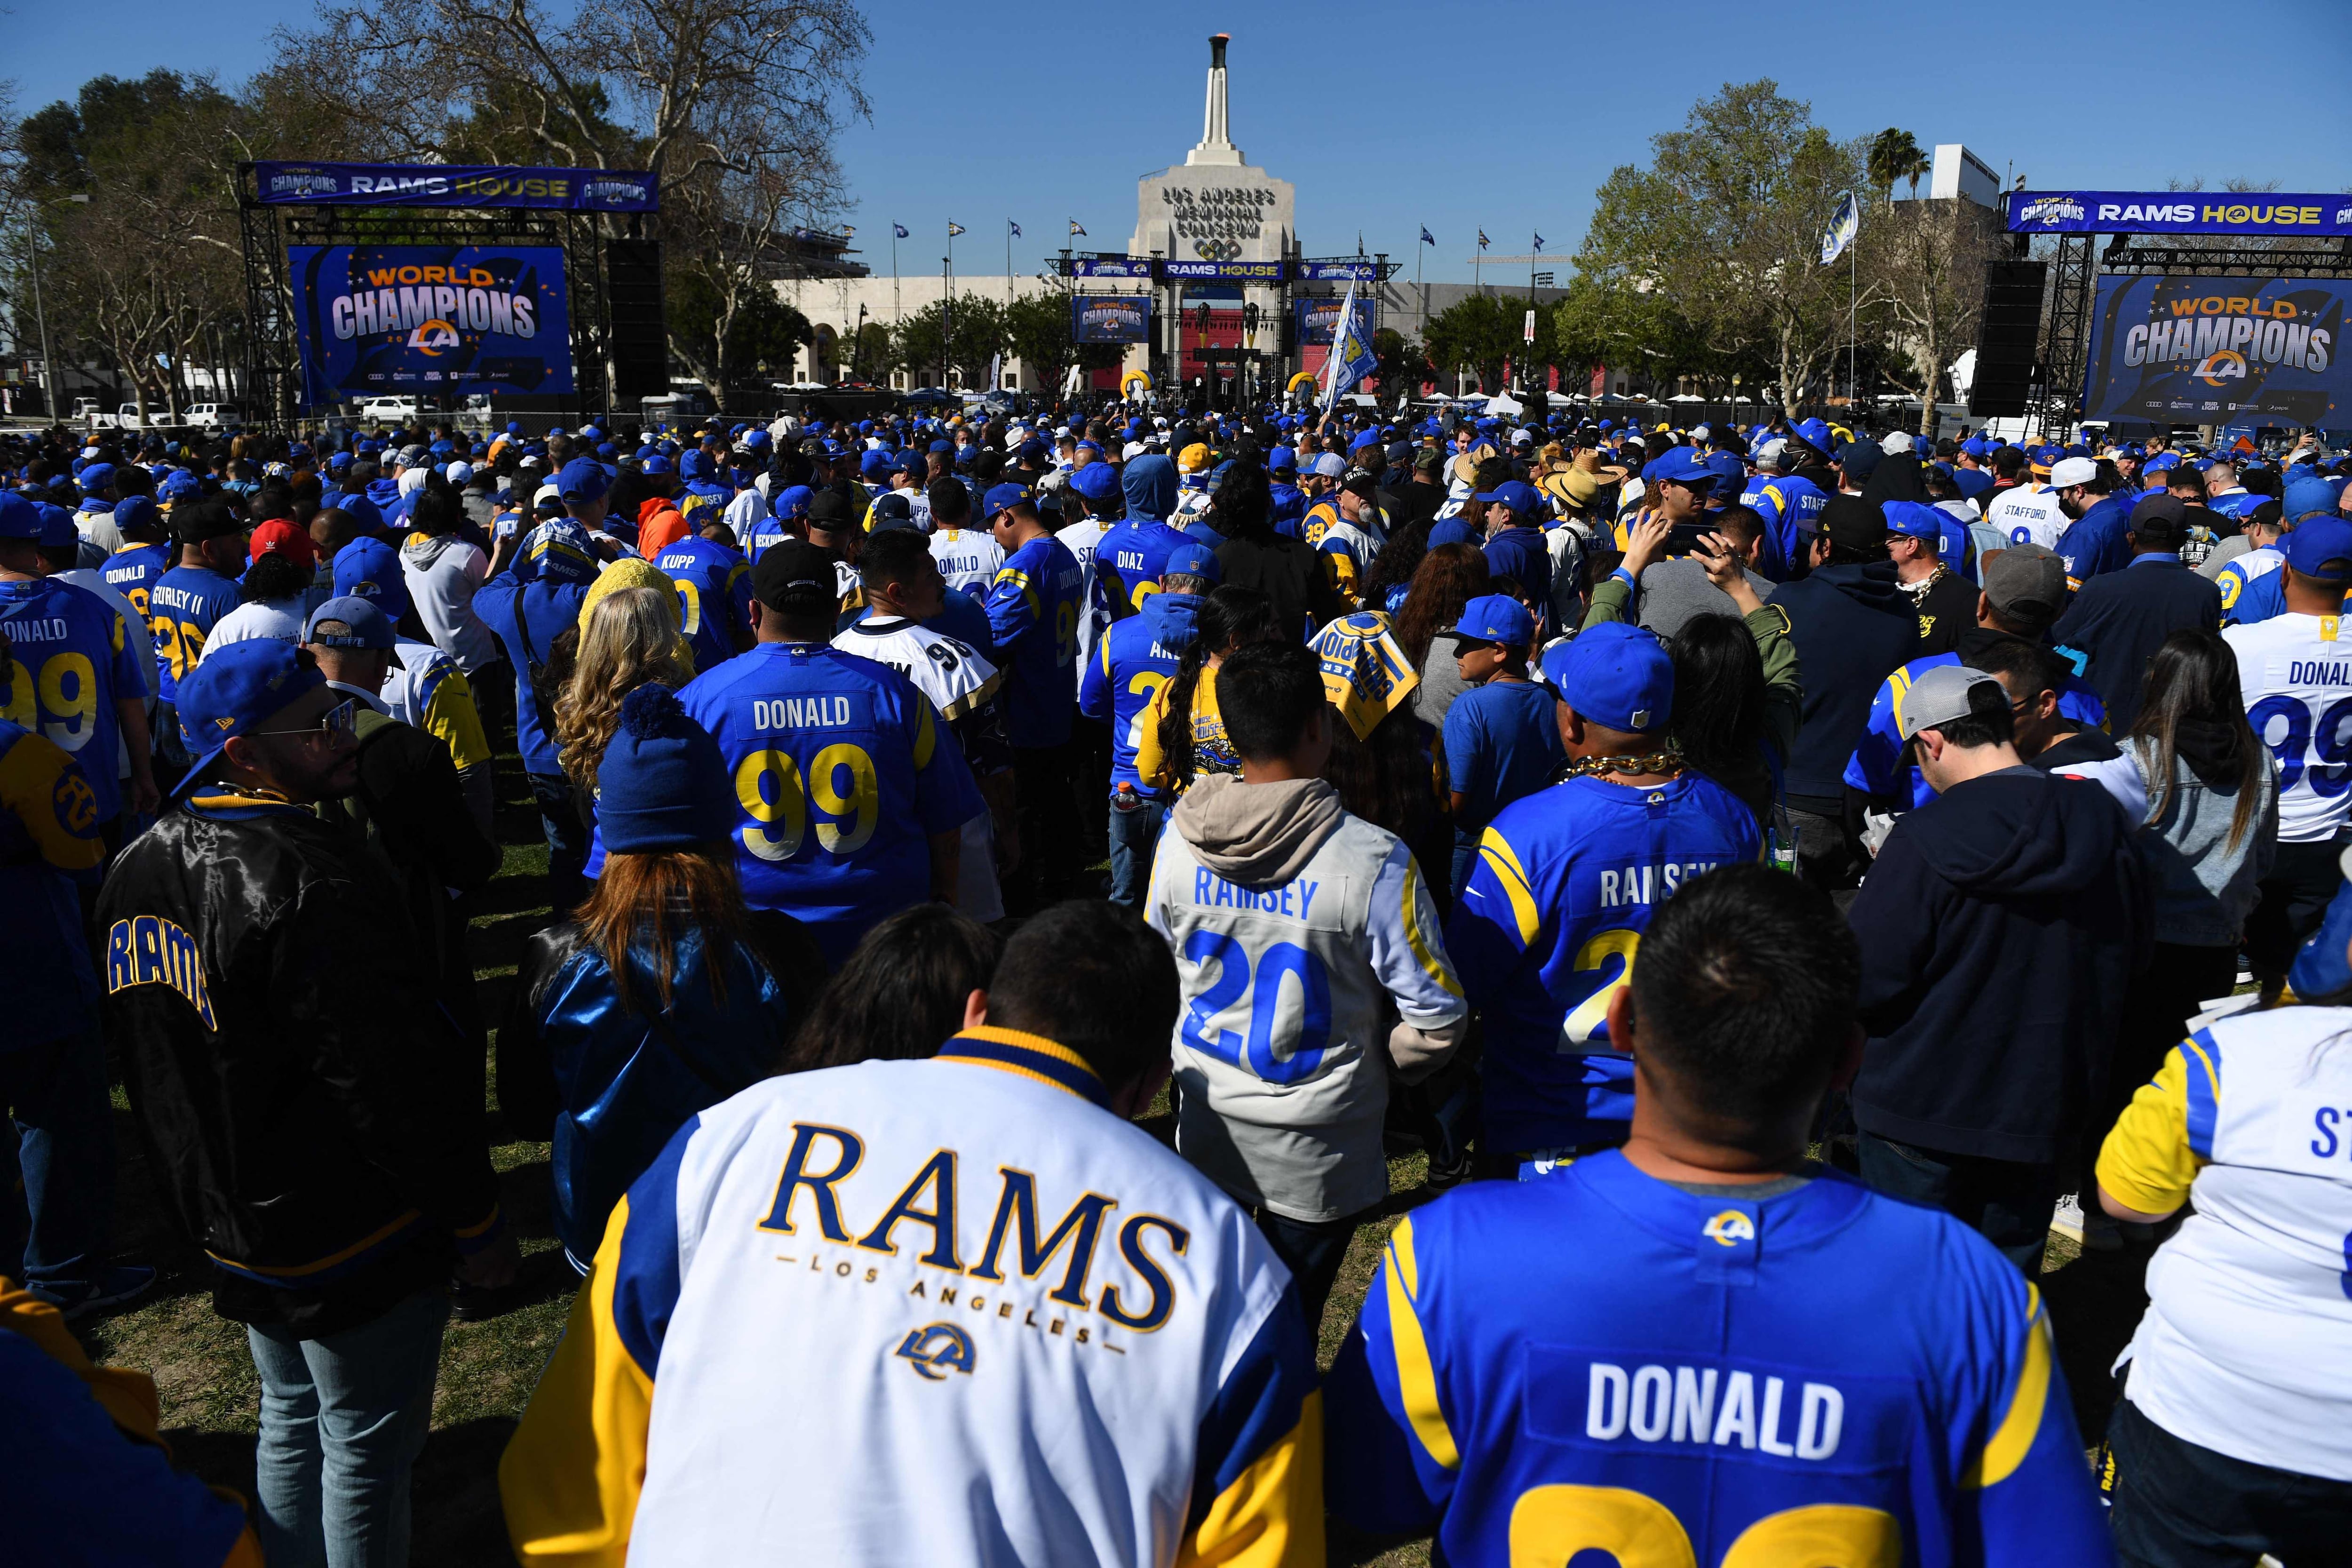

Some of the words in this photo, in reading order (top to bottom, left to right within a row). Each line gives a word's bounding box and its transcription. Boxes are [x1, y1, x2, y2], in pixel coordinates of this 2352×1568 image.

[271, 174, 337, 192] CHAMPIONS
[351, 176, 449, 194] RAMS
[455, 177, 571, 198] HOUSE
[583, 182, 646, 201] CHAMPIONS
[1162, 186, 1192, 202] LOS
[1200, 187, 1275, 203] ANGELES
[1173, 204, 1261, 220] MEMORIAL
[2020, 203, 2084, 221] CHAMPIONS
[2098, 204, 2195, 223] RAMS
[2202, 205, 2322, 224] HOUSE
[1176, 220, 1258, 236] COLISEUM
[368, 265, 495, 287] WORLD
[1092, 265, 1128, 276] CHAMPIONS
[1167, 264, 1216, 276] RAMS
[1219, 265, 1278, 276] HOUSE
[332, 286, 535, 340] CHAMPIONS
[1082, 309, 1142, 326] CHAMPIONS
[2170, 296, 2298, 318] WORLD
[2124, 316, 2331, 372] CHAMPIONS
[1801, 495, 1829, 511] STAFF
[2005, 505, 2047, 520] STAFFORD
[540, 557, 581, 577] RAMS
[661, 555, 696, 570] KUPP
[1117, 550, 1144, 571] DIAZ
[106, 564, 145, 584] DONALD
[153, 585, 191, 610] GURLEY
[191, 595, 204, 615] II
[2, 618, 68, 643] ONALD
[926, 636, 973, 672] 98
[2289, 661, 2352, 686] DONAL
[753, 696, 850, 731] DONALD
[1194, 716, 1212, 725] WHOSE
[2246, 695, 2352, 798] 99
[736, 743, 879, 861] 99
[1194, 865, 1319, 921] RAMSEY
[1181, 928, 1332, 1086] 20
[755, 1121, 1190, 1334] RAMS
[809, 1254, 879, 1284] LOS
[909, 1280, 1091, 1345] ANGELES
[1586, 1361, 1845, 1460] DONALD
